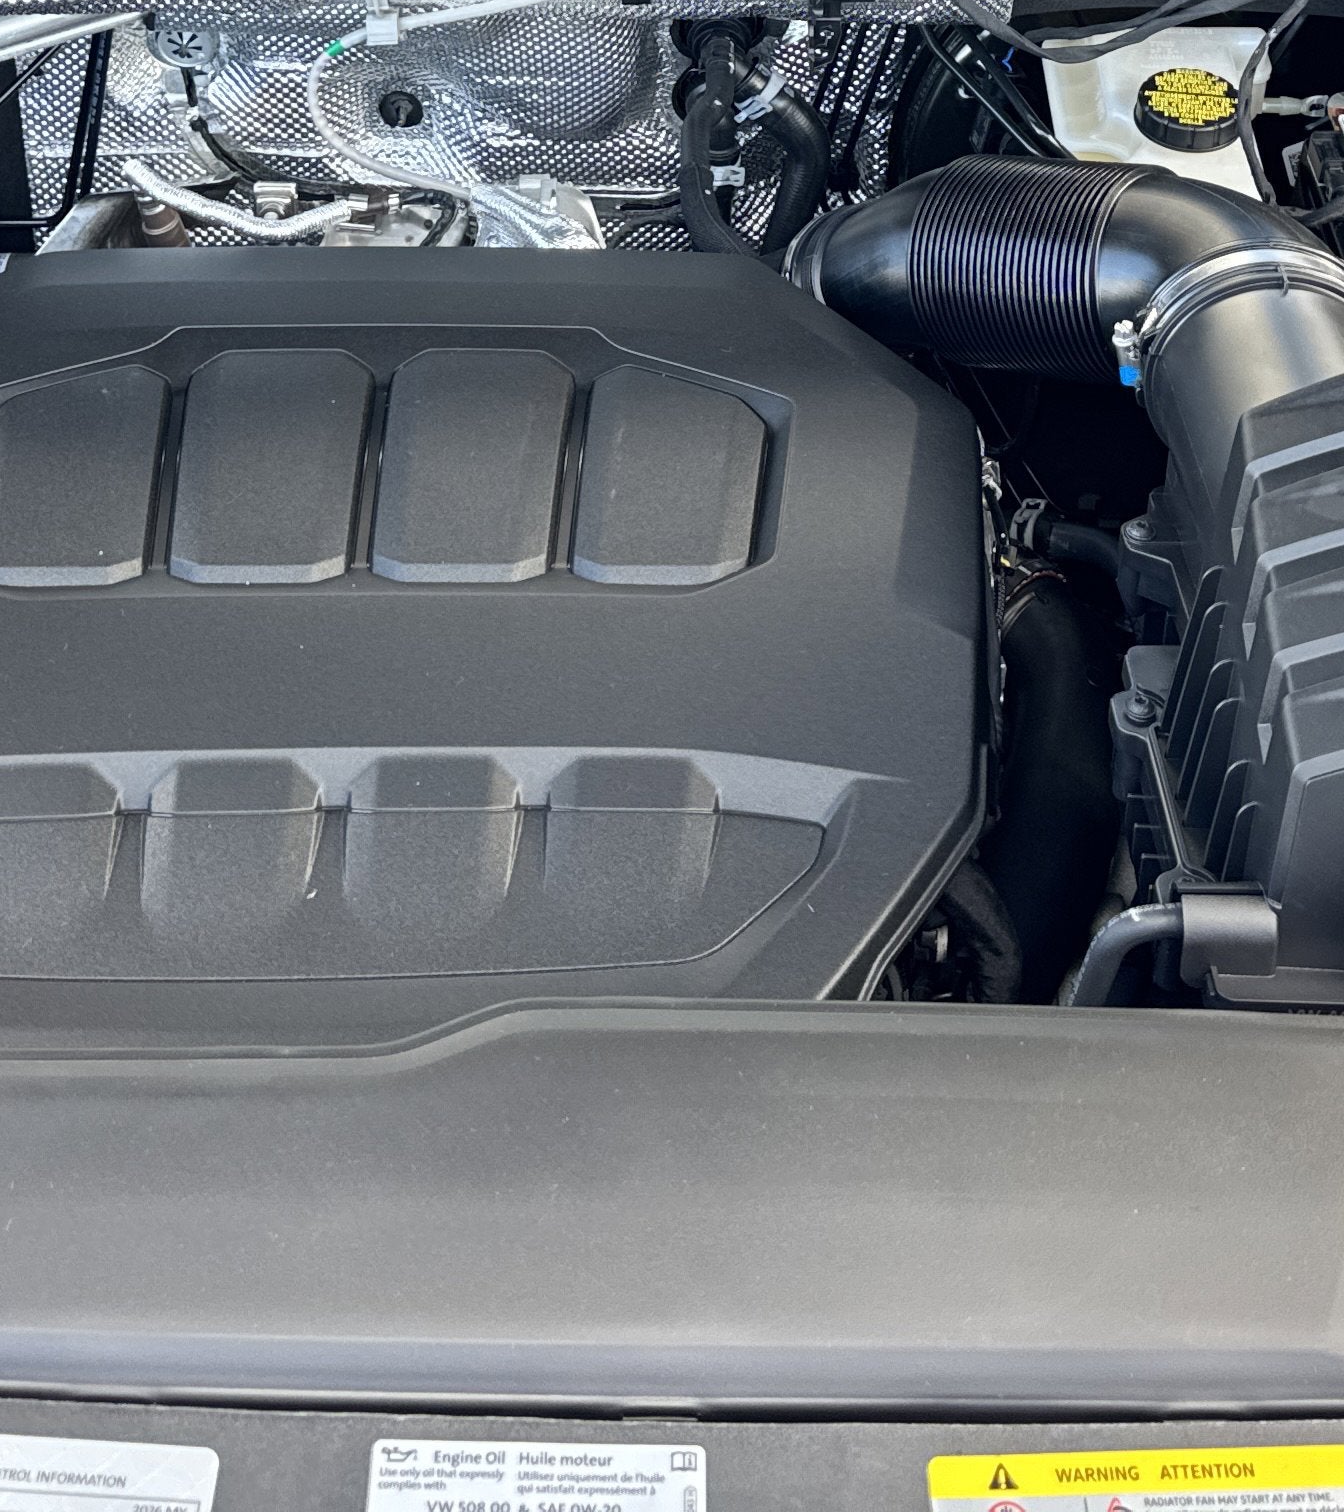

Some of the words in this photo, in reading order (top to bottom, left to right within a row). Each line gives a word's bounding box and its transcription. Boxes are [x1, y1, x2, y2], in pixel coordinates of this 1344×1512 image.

[434, 1450, 483, 1467] Engine
[485, 1450, 506, 1465] Oil
[518, 1451, 557, 1466] Huile
[559, 1453, 614, 1467] moteur
[379, 1467, 398, 1477] Use
[399, 1466, 421, 1480] only
[422, 1467, 435, 1478] oil
[436, 1467, 457, 1478] that
[458, 1468, 505, 1482] expressly
[518, 1470, 555, 1481] Utilisez
[557, 1472, 618, 1484] uniquement
[620, 1472, 633, 1483] de
[635, 1473, 666, 1484] l'huile
[1056, 1465, 1140, 1483] WARNING
[1160, 1462, 1256, 1480] ATTENTION
[35, 1471, 127, 1489] INFORMATION
[378, 1480, 422, 1491] complies
[423, 1479, 447, 1490] with
[517, 1483, 534, 1496] qui
[536, 1483, 575, 1494] satisfait
[577, 1484, 647, 1497] expressément
[426, 1500, 455, 1512] VW
[458, 1500, 486, 1512] 508
[489, 1501, 511, 1512] 00
[1143, 1495, 1194, 1507] RADIATOR
[1195, 1495, 1216, 1506] FAN
[1217, 1495, 1238, 1505] MAY
[1240, 1494, 1270, 1505] START
[1272, 1493, 1284, 1504] AT
[1286, 1493, 1306, 1503] ANY
